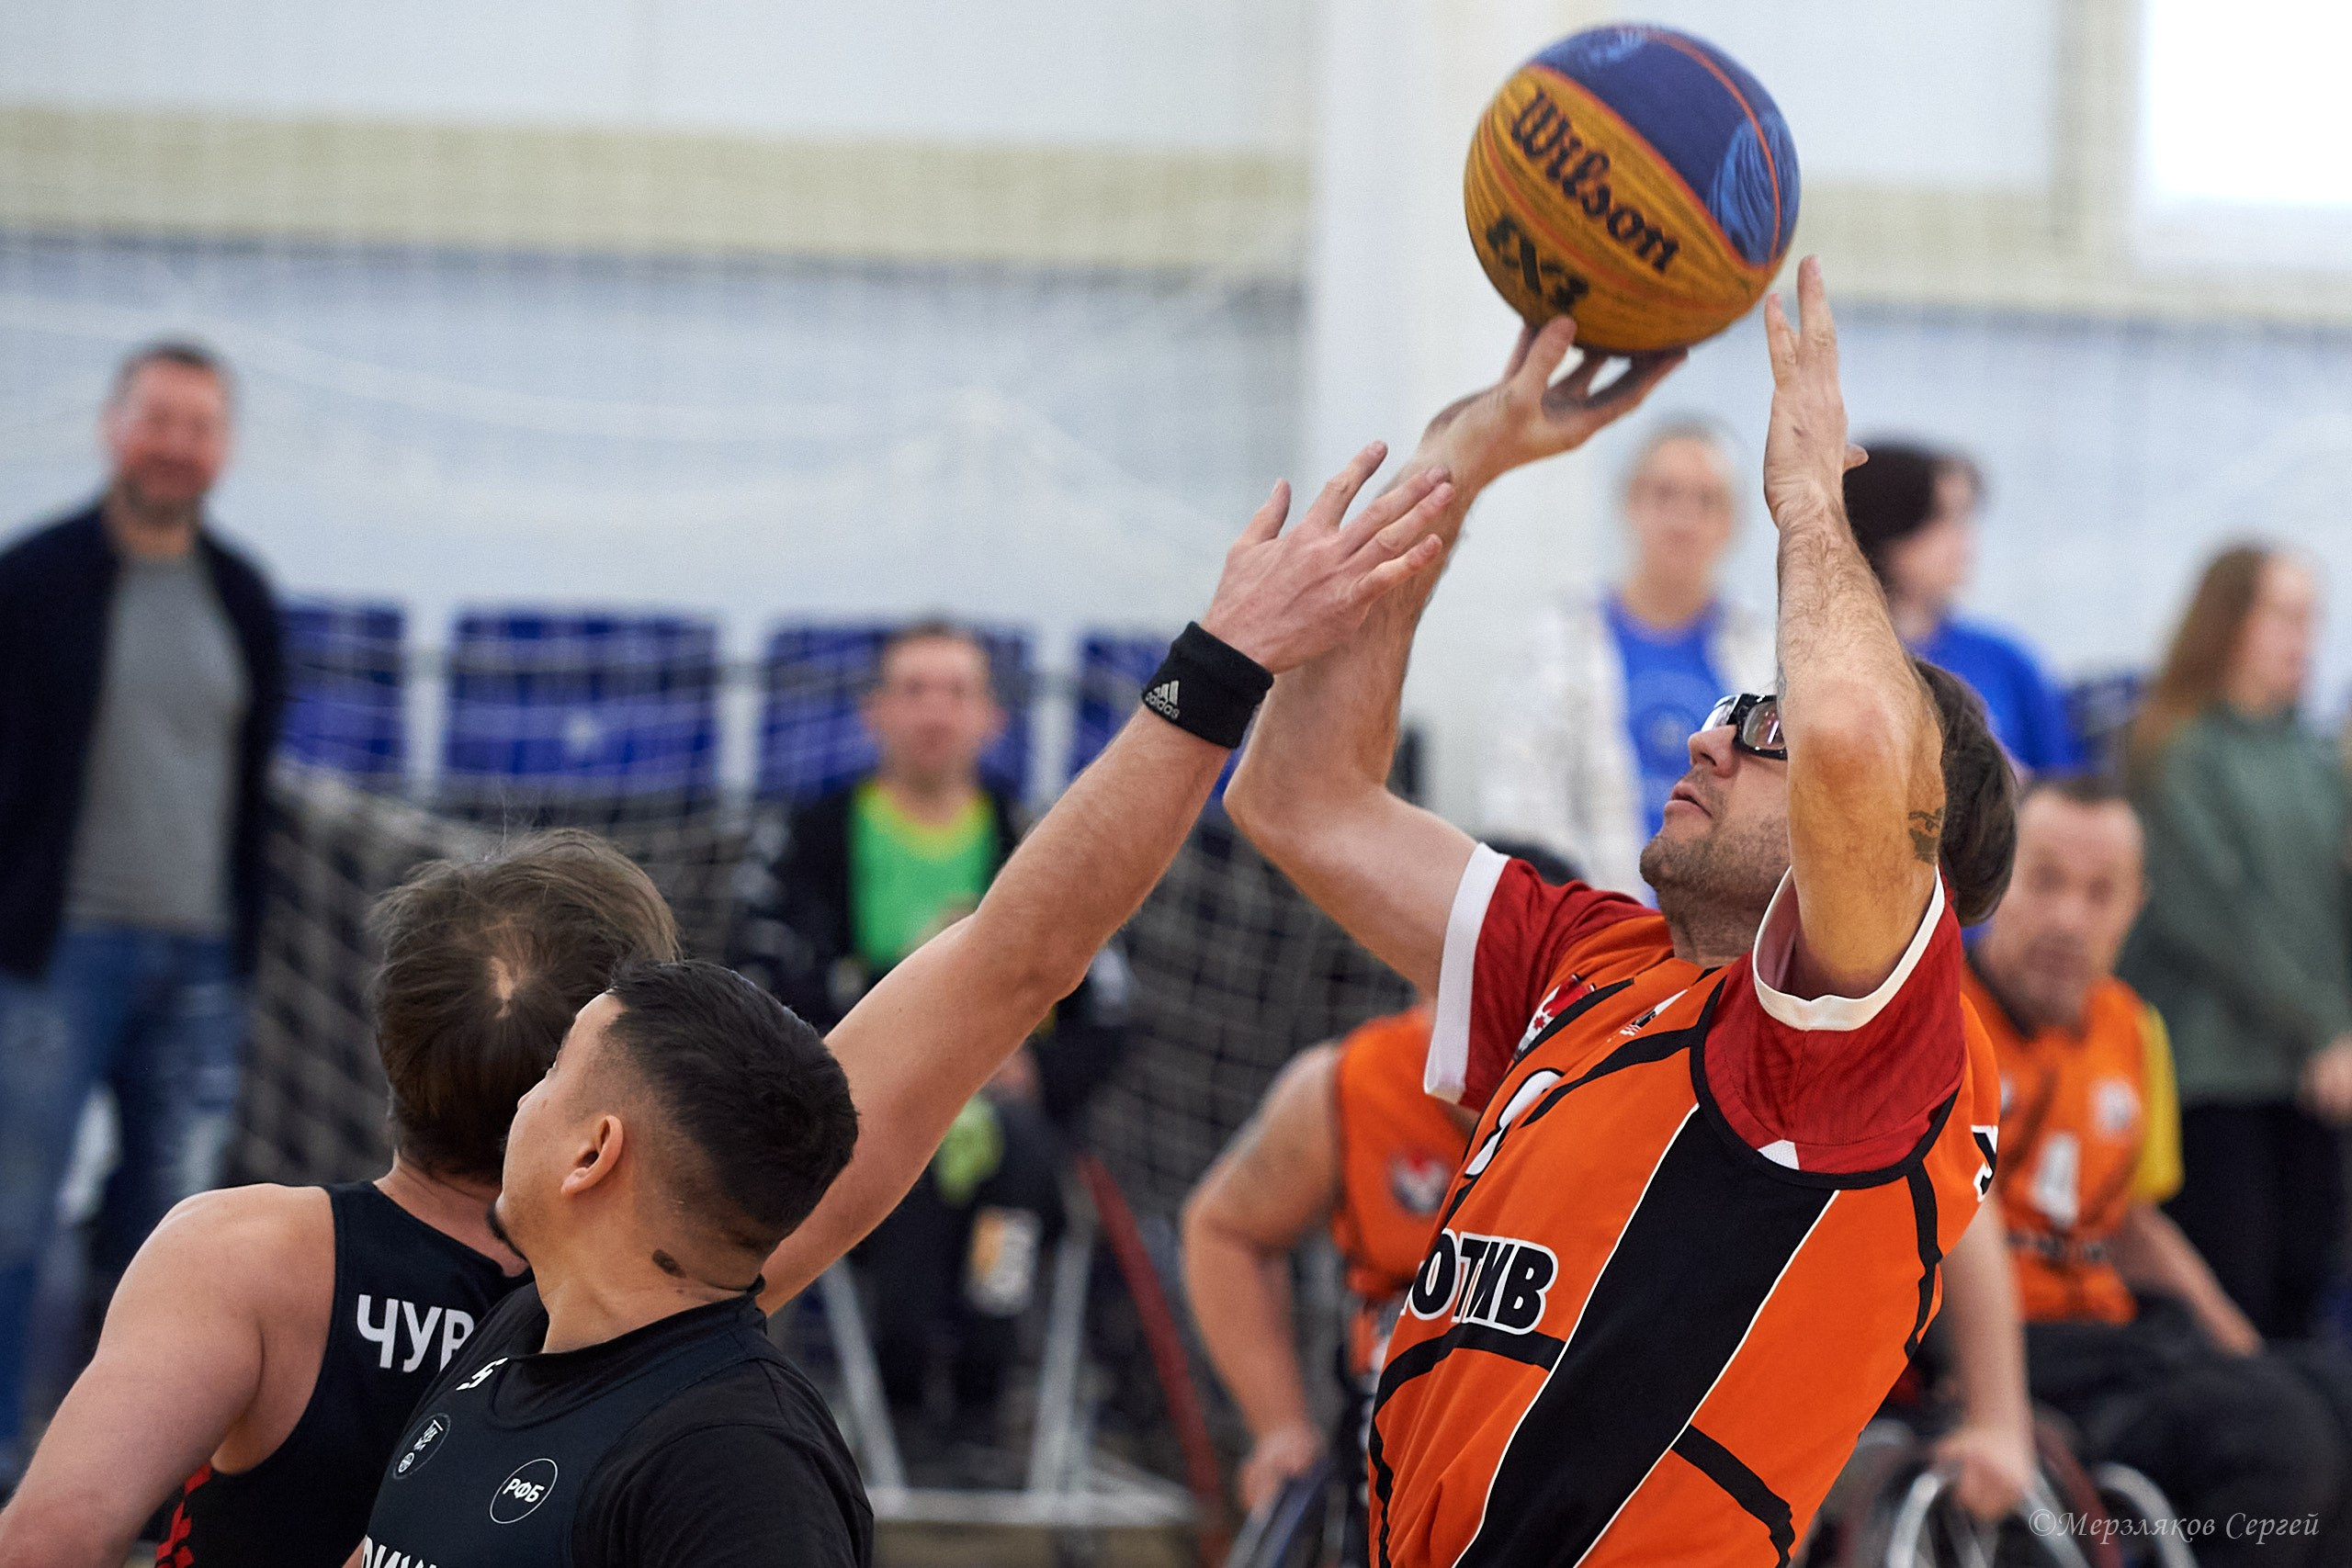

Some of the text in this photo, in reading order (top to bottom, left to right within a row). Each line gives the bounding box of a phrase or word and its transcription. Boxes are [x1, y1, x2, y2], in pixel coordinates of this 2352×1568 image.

[1510, 85, 1679, 273] Wilson
[1146, 693, 1181, 718] adidas
[1400, 1227, 1559, 1335] ОТИВ
[502, 1478, 545, 1503] РФБ
